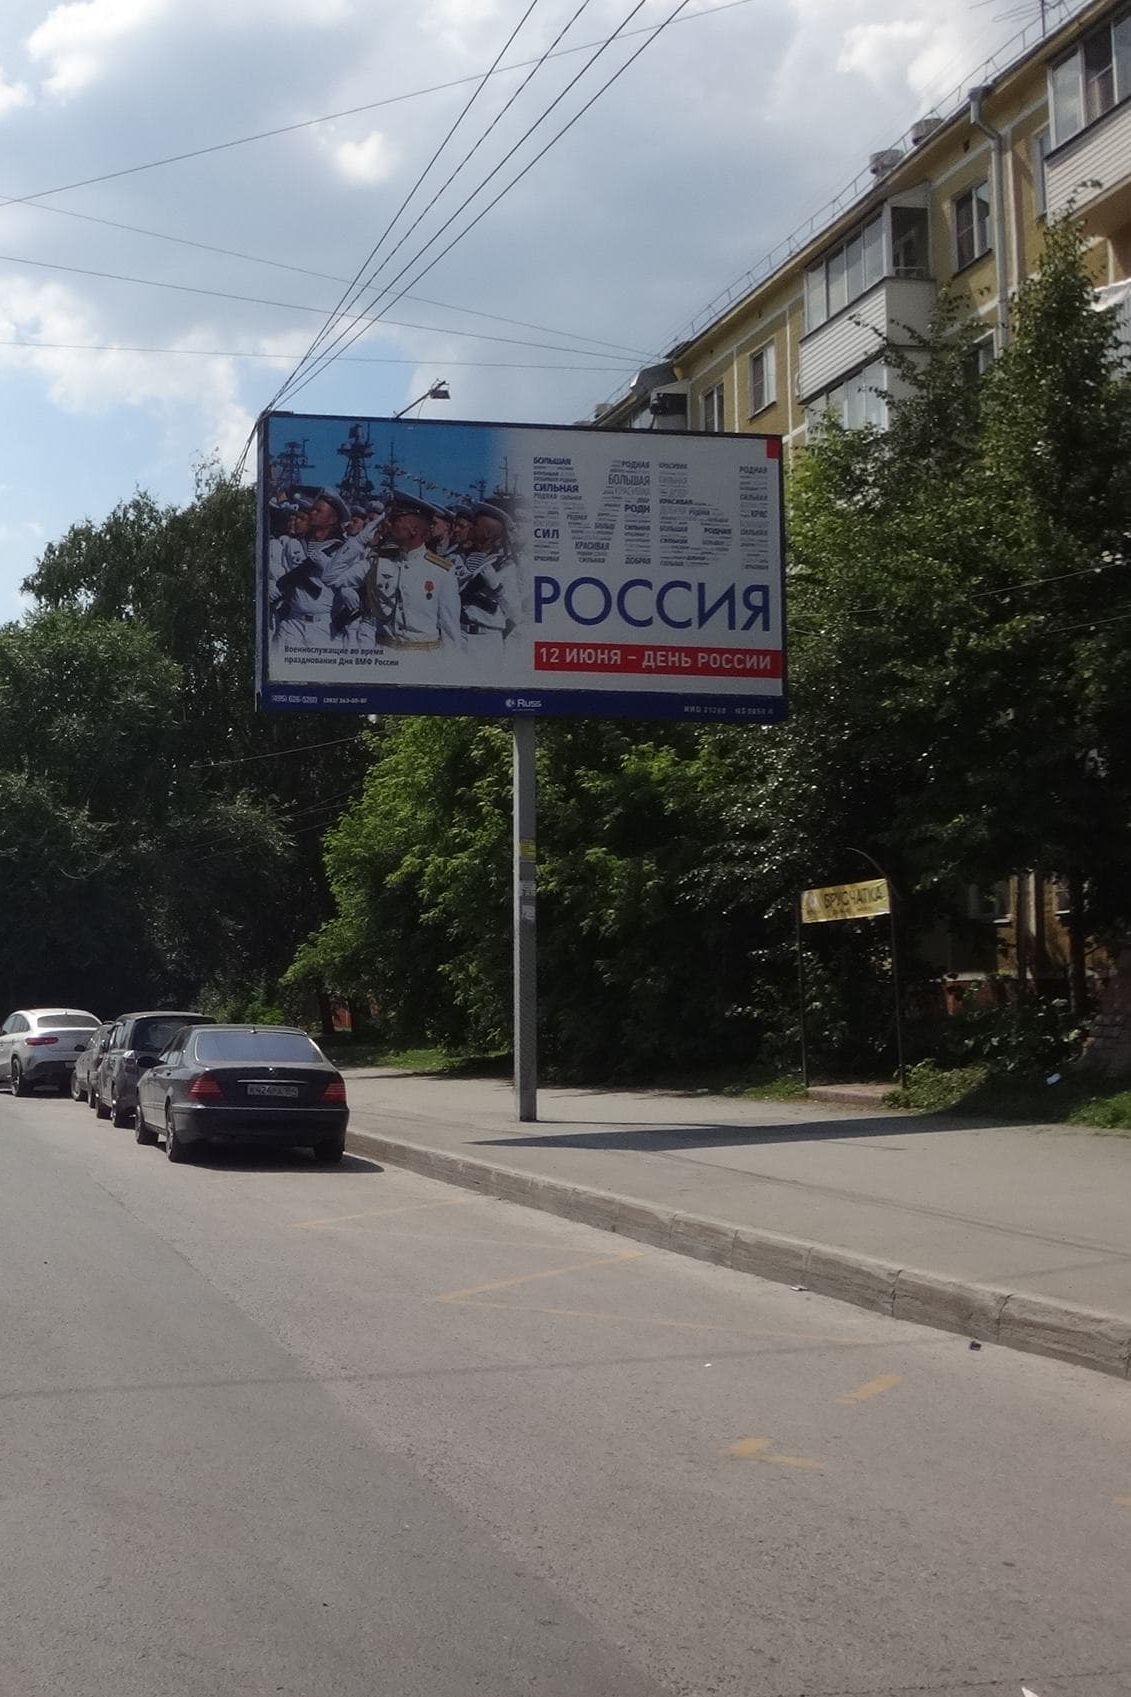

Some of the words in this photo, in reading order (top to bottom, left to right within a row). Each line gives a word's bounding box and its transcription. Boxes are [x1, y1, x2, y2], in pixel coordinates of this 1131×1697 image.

[533, 456, 571, 466] БОЛЬШАЯ
[621, 460, 650, 469] РОДНАЯ
[739, 465, 768, 474] РОДНАЯ
[608, 473, 651, 486] БОЛЬШАЯ
[533, 483, 579, 493] СИЛЬНАЯ
[624, 504, 651, 514] РОДН
[534, 528, 560, 539] СИЛ
[534, 575, 771, 632] РОССИЯ
[284, 645, 348, 656] Военнослужащие
[361, 648, 384, 656] время
[284, 657, 337, 665] празднования
[338, 657, 353, 666] Дня
[355, 658, 373, 666] ВМФ
[374, 659, 399, 667] России
[540, 647, 559, 663] 12
[565, 648, 621, 665] ИЮНЯ
[642, 650, 692, 669] ДЕНЬ
[697, 652, 771, 670] РОССИИ
[517, 698, 542, 708] Russ
